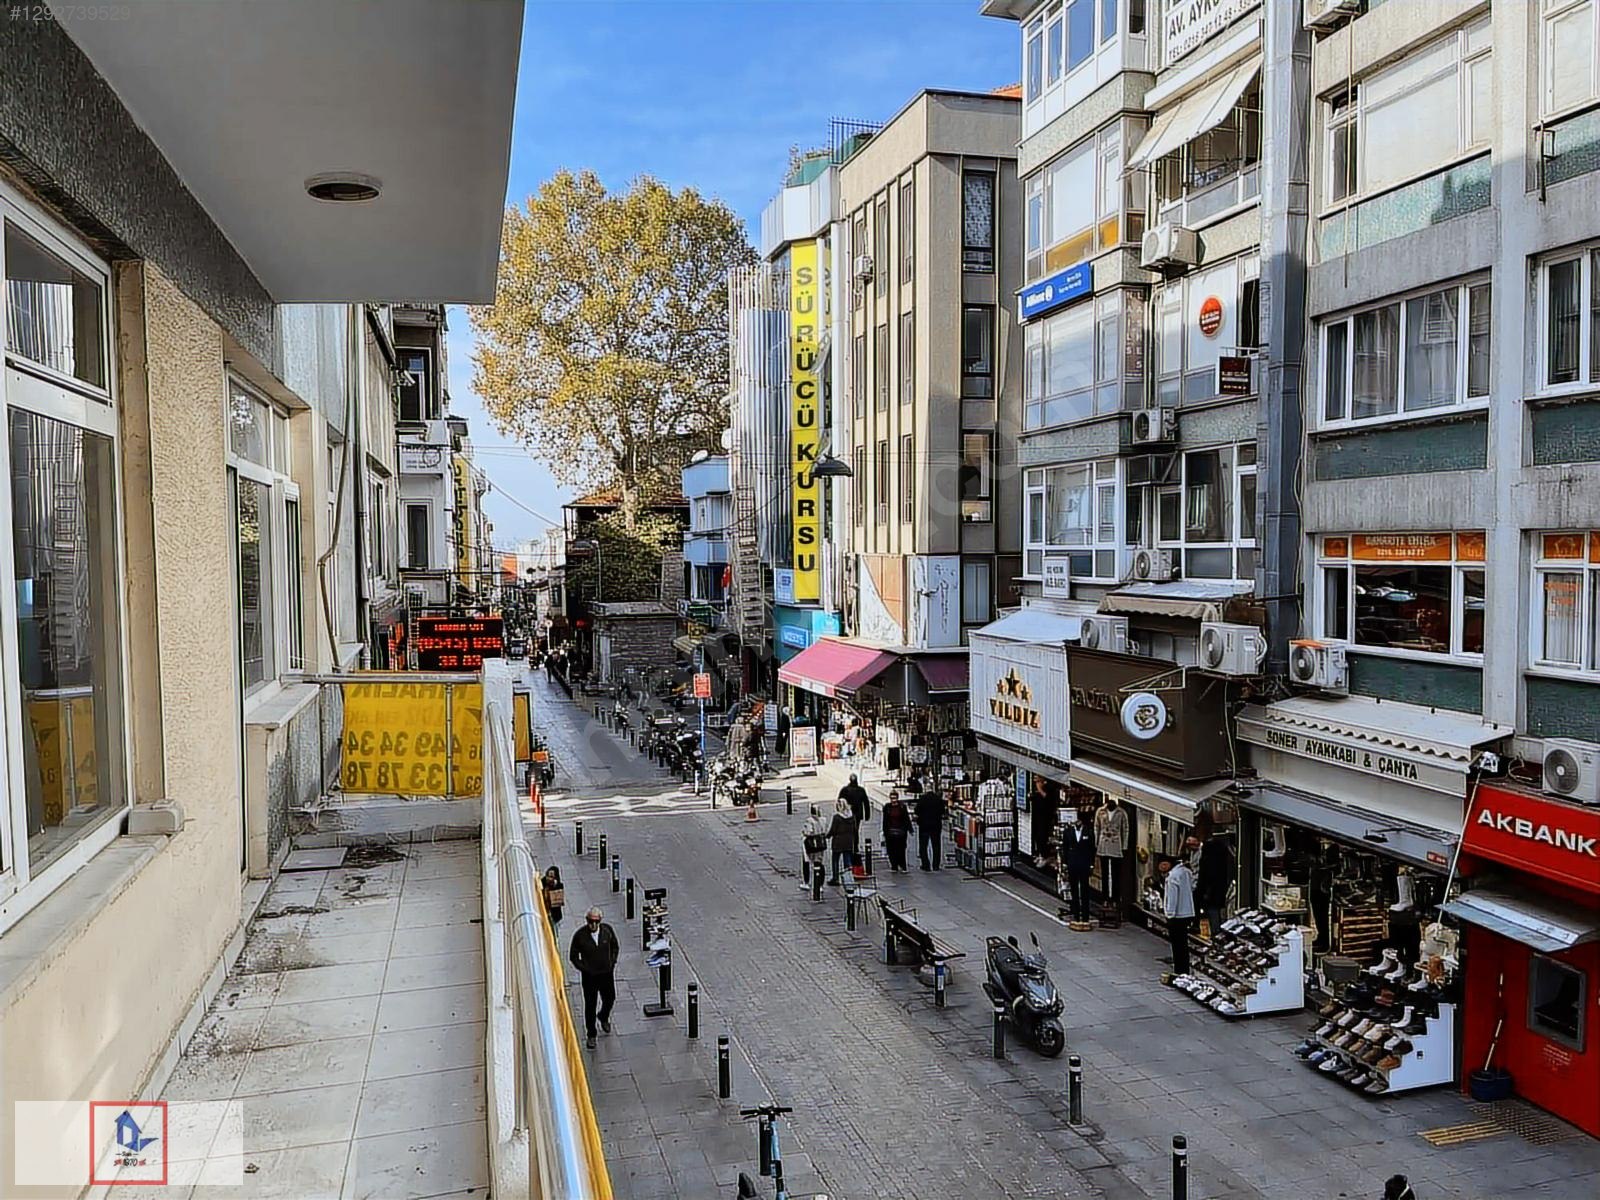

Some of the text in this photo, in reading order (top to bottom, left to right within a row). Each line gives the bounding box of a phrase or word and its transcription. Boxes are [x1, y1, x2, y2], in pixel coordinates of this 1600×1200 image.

[796, 265, 816, 572] SÜRÜCÜ KURSU
[989, 698, 1039, 729] YILDIZ
[1266, 730, 1418, 780] SONER AYAKKABI & ÇANTA
[1477, 809, 1597, 857] AKBANK
